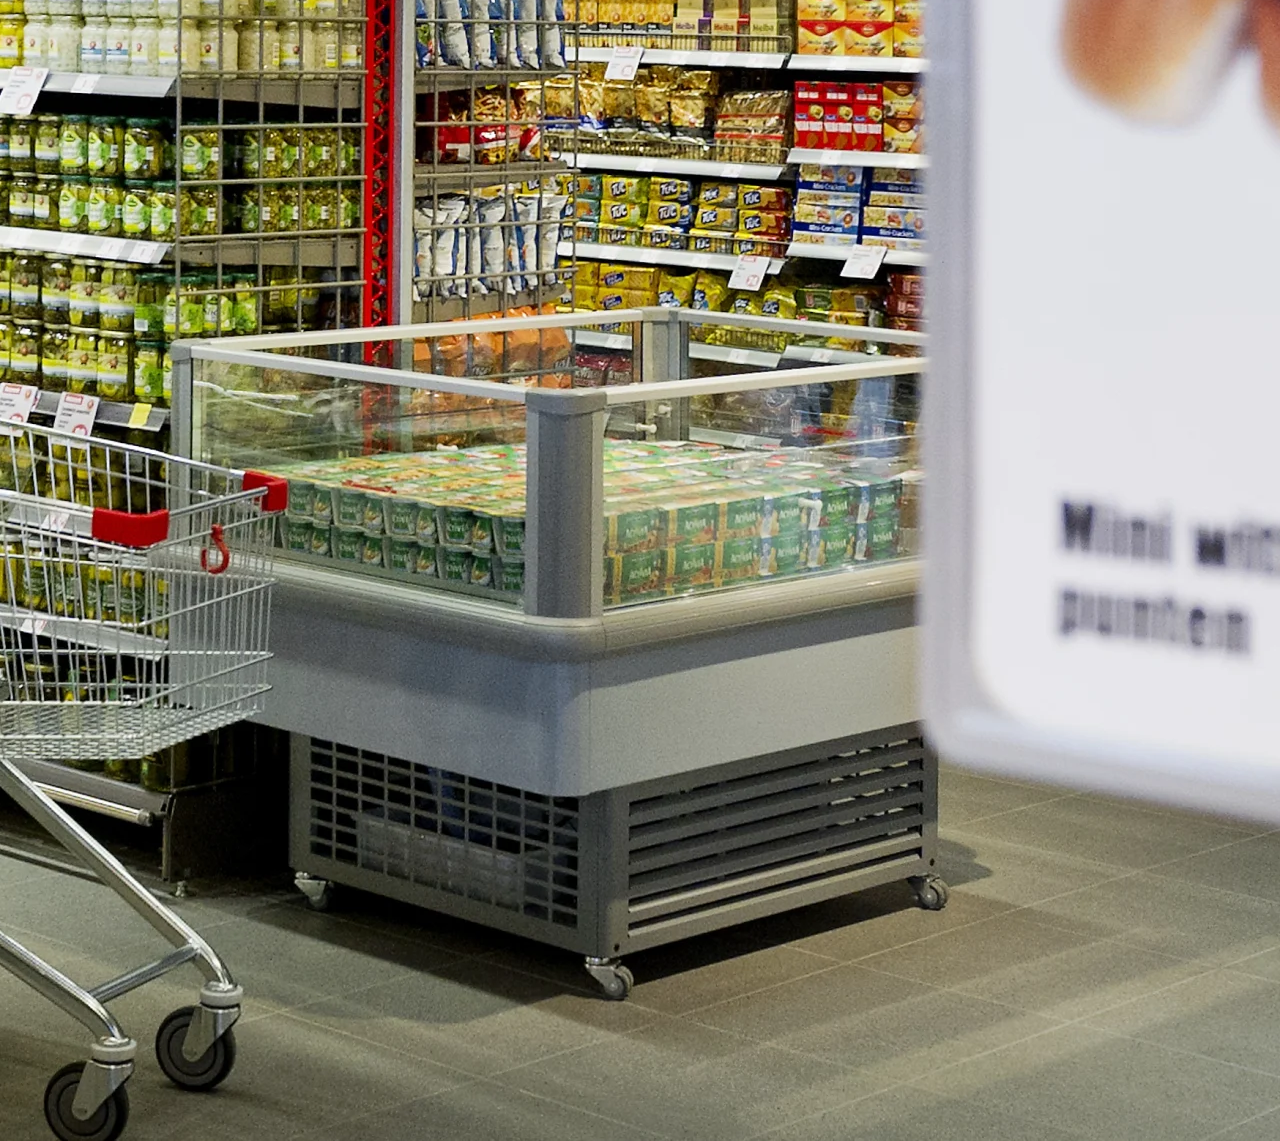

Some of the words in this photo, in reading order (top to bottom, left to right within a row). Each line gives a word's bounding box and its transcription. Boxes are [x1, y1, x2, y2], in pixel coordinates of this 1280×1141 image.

[675, 22, 696, 30] Melba
[713, 22, 735, 31] Melba
[611, 182, 626, 196] TUC
[660, 181, 678, 195] TUC
[744, 192, 761, 205] TUC
[611, 204, 627, 219] TUC
[659, 205, 677, 219] TUC
[701, 210, 717, 223] TUC
[744, 215, 761, 229] TUC
[1062, 501, 1173, 562] Mini
[1060, 590, 1252, 655] punten
